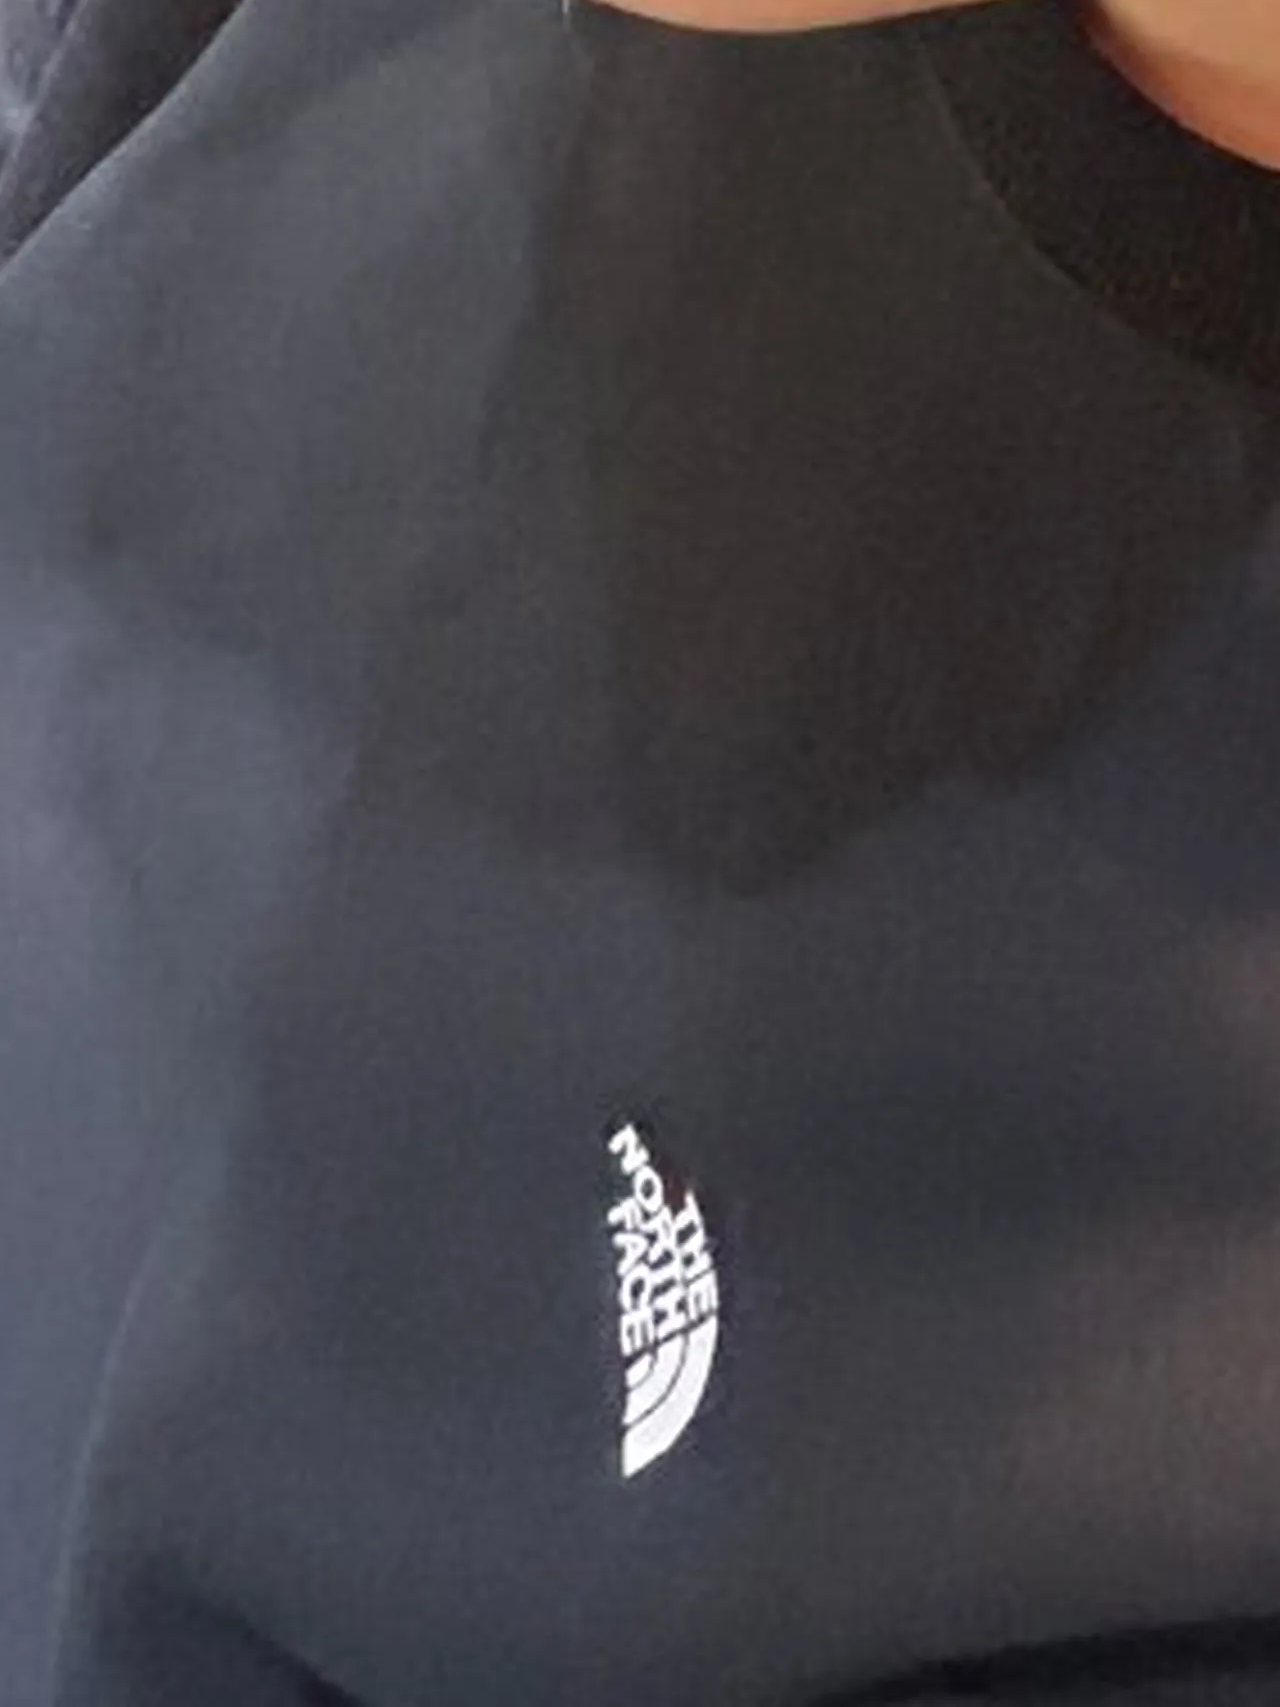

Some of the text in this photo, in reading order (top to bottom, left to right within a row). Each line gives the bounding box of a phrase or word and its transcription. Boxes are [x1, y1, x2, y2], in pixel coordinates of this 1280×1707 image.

[607, 1197, 655, 1356] FACE
[608, 1124, 688, 1340] NORTH
[672, 1189, 719, 1322] THE
